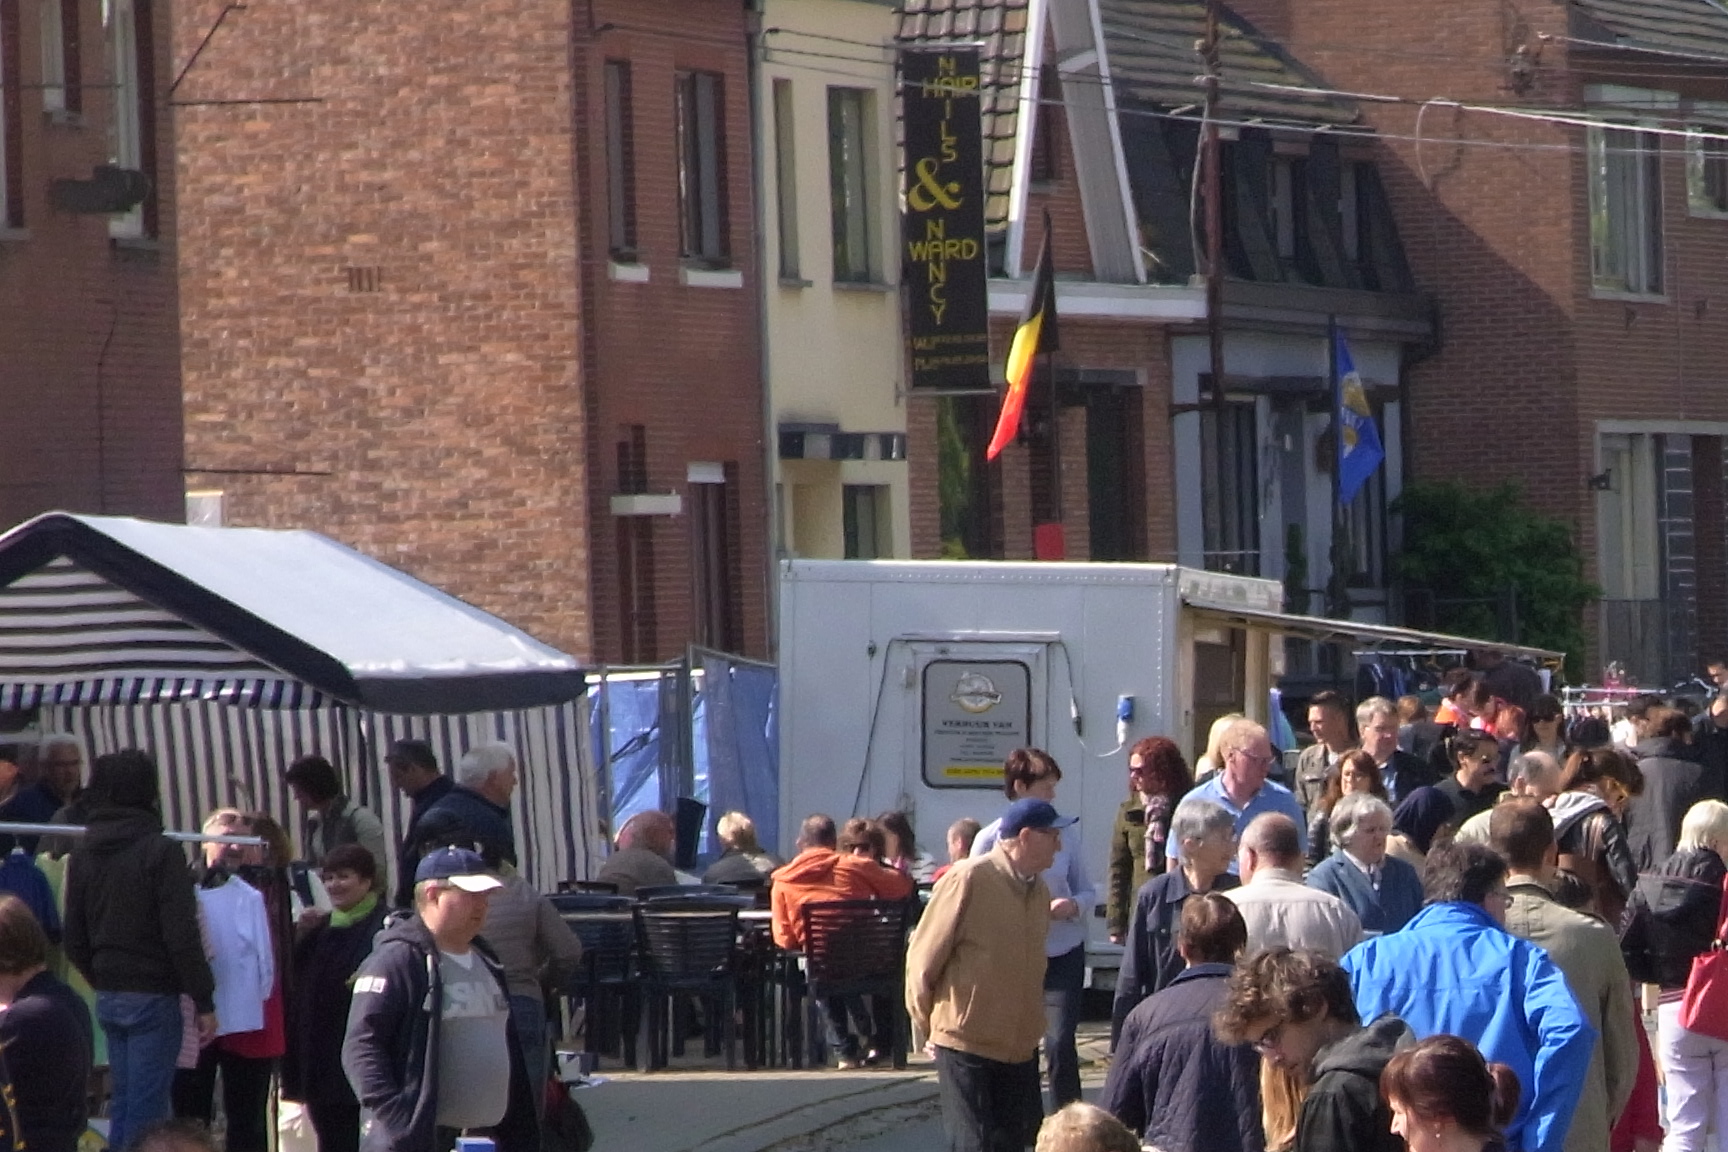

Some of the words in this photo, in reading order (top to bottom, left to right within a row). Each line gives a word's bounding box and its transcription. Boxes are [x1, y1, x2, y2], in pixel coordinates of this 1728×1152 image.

[923, 76, 977, 98] HAIR
[908, 157, 963, 212] &
[908, 239, 978, 262] WARD
